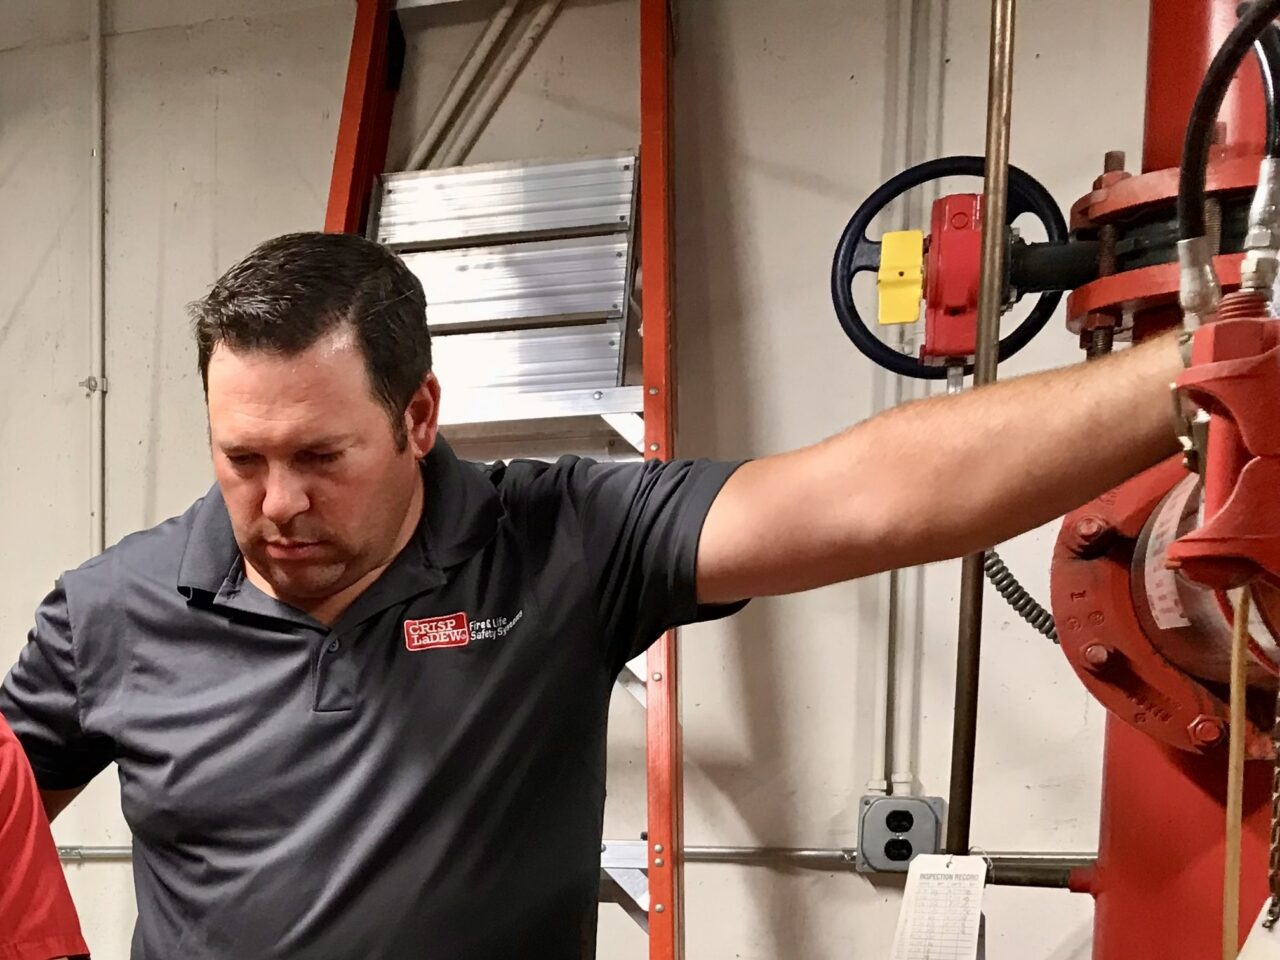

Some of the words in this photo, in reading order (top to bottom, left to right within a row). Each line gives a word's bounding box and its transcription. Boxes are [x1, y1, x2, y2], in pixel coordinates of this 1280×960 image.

[408, 619, 456, 636] CRISP
[469, 620, 485, 631] Fire
[492, 617, 507, 628] Life
[470, 628, 496, 641] Safety
[920, 873, 954, 881] INSPECTION
[954, 873, 979, 881] RECORD
